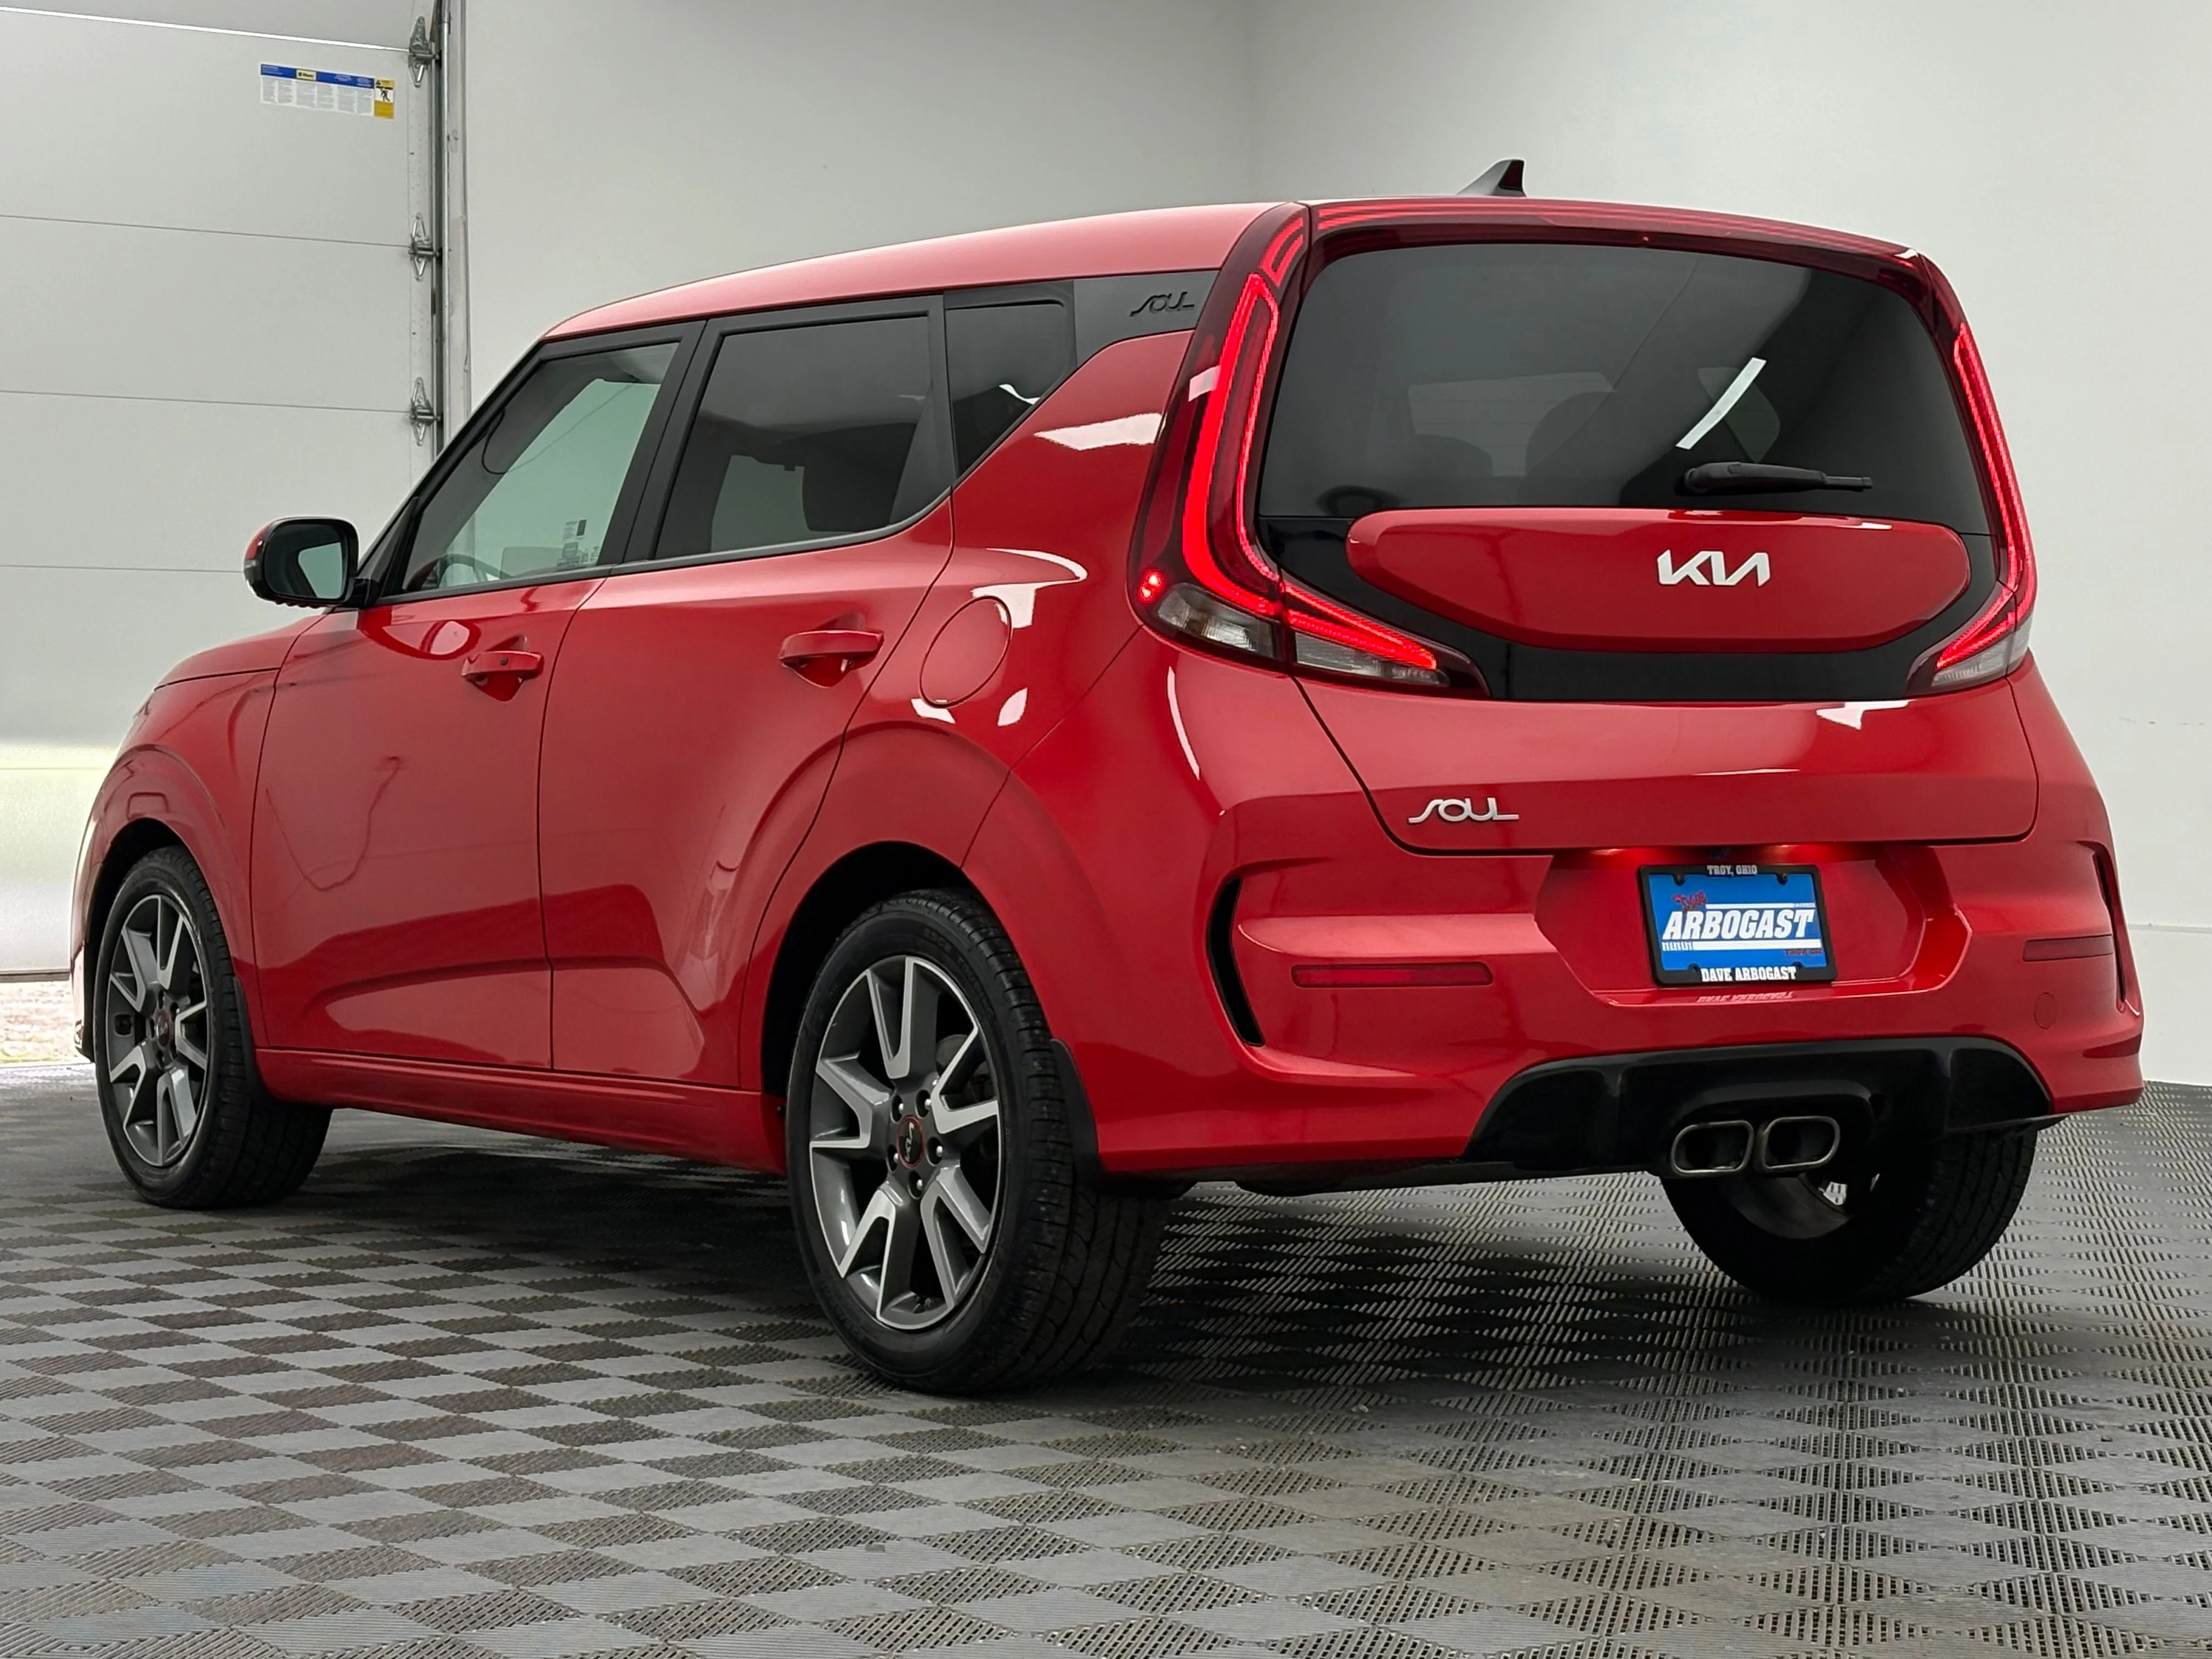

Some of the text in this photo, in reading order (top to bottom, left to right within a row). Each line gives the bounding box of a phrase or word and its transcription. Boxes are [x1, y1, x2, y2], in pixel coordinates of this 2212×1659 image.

[1657, 549, 1770, 587] KIA
[1408, 797, 1520, 823] SOUL
[1707, 865, 1757, 876] TROY, OHIO
[1662, 909, 1815, 940] ARBOGAST
[1701, 966, 1797, 982] DAVE ARBOGAST
